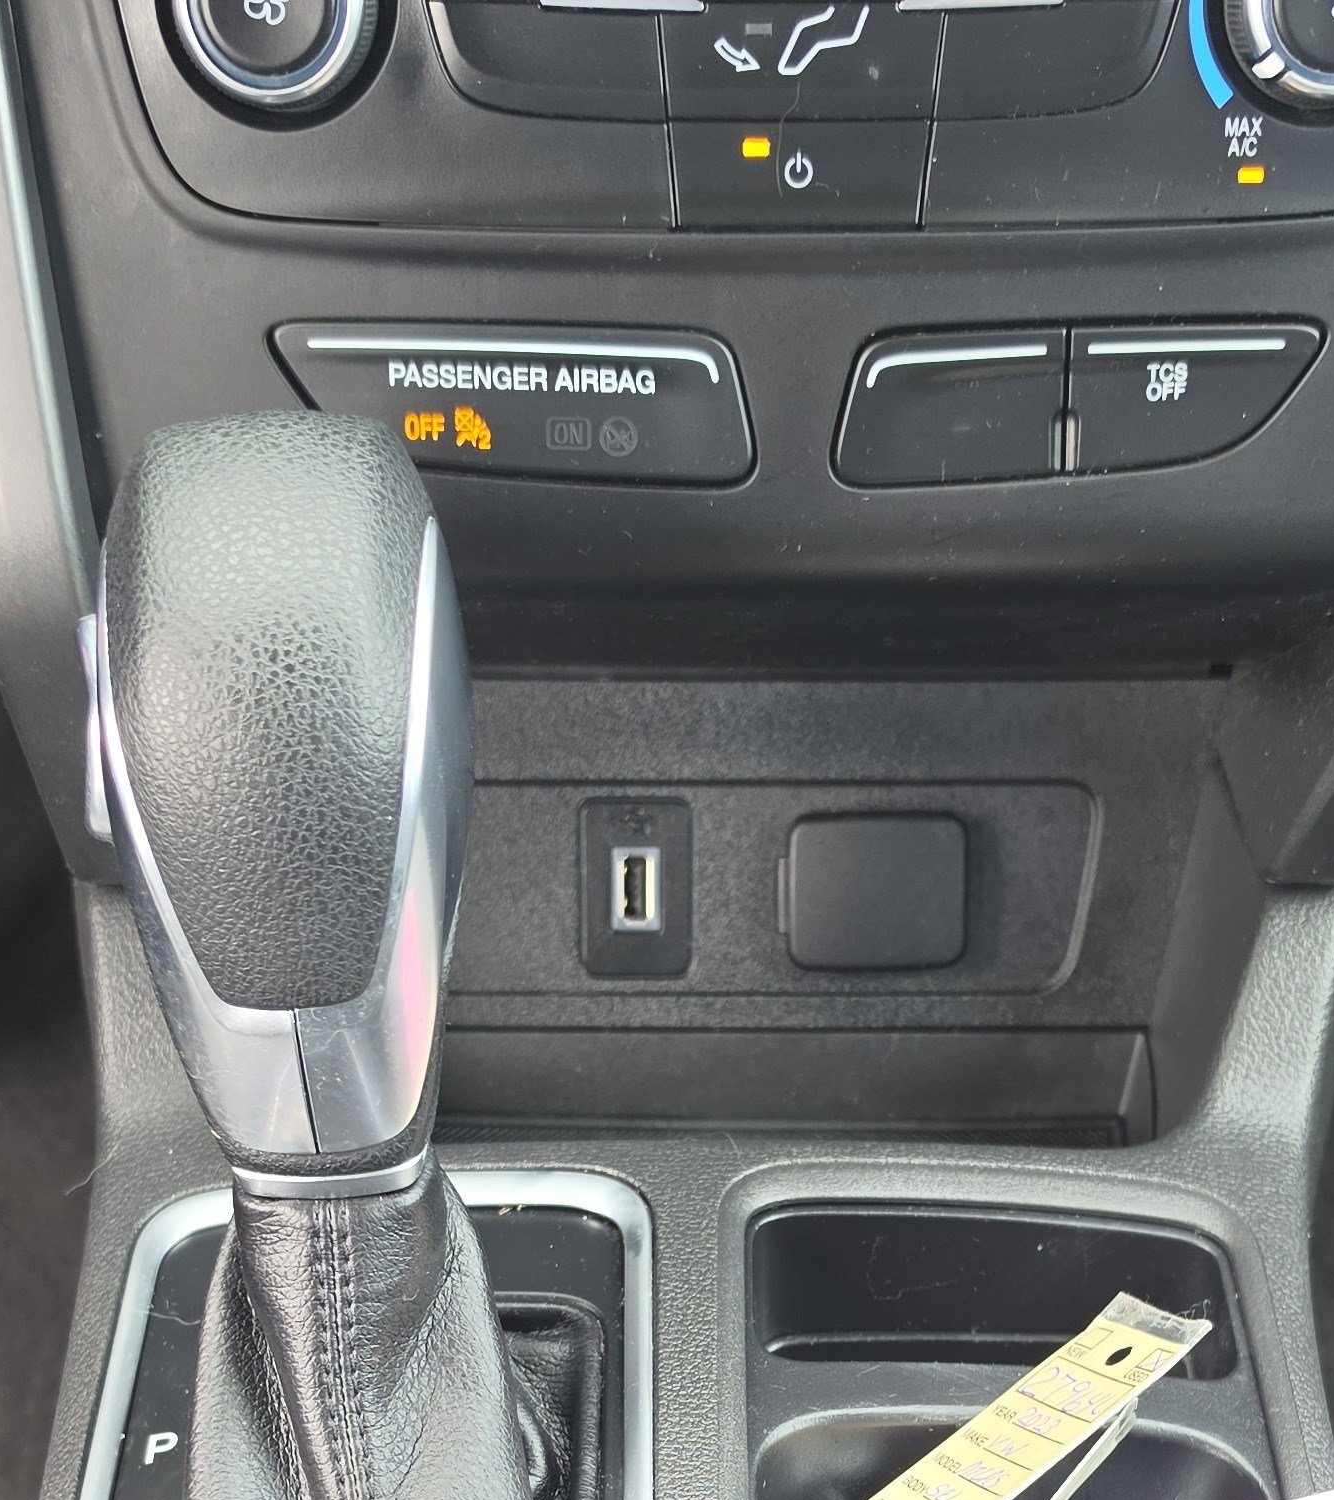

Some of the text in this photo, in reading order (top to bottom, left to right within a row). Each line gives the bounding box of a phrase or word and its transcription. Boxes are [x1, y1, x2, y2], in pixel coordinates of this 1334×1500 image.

[1224, 116, 1263, 137] MAX
[1227, 137, 1258, 157] A/C
[388, 360, 657, 395] PASSENGER AIRBAG
[1146, 361, 1189, 383] TCS
[1145, 382, 1187, 402] OFF
[404, 412, 445, 441] OFF
[553, 421, 584, 445] ON
[991, 1403, 1017, 1424] YEAR
[1017, 1406, 1062, 1434] 2023
[144, 1431, 178, 1465] P
[902, 1475, 929, 1496] BODY
